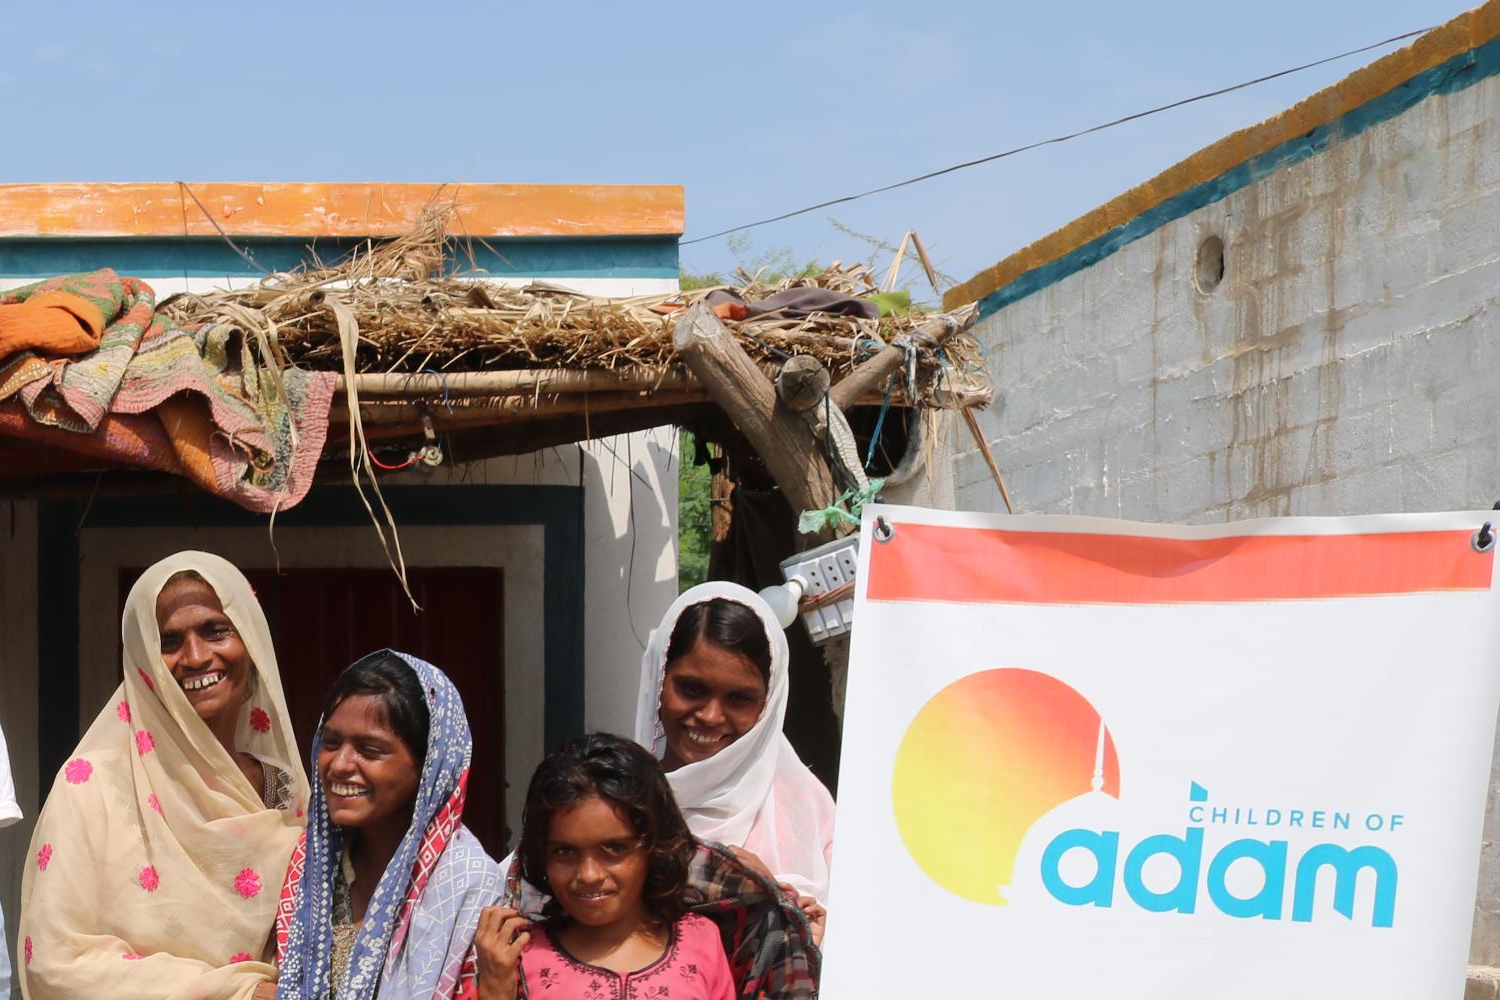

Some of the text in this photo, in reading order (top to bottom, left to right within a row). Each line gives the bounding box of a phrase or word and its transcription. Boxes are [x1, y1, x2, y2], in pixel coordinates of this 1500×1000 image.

[1188, 805, 1405, 833] CHILDREN OF
[1040, 824, 1399, 929] adam
